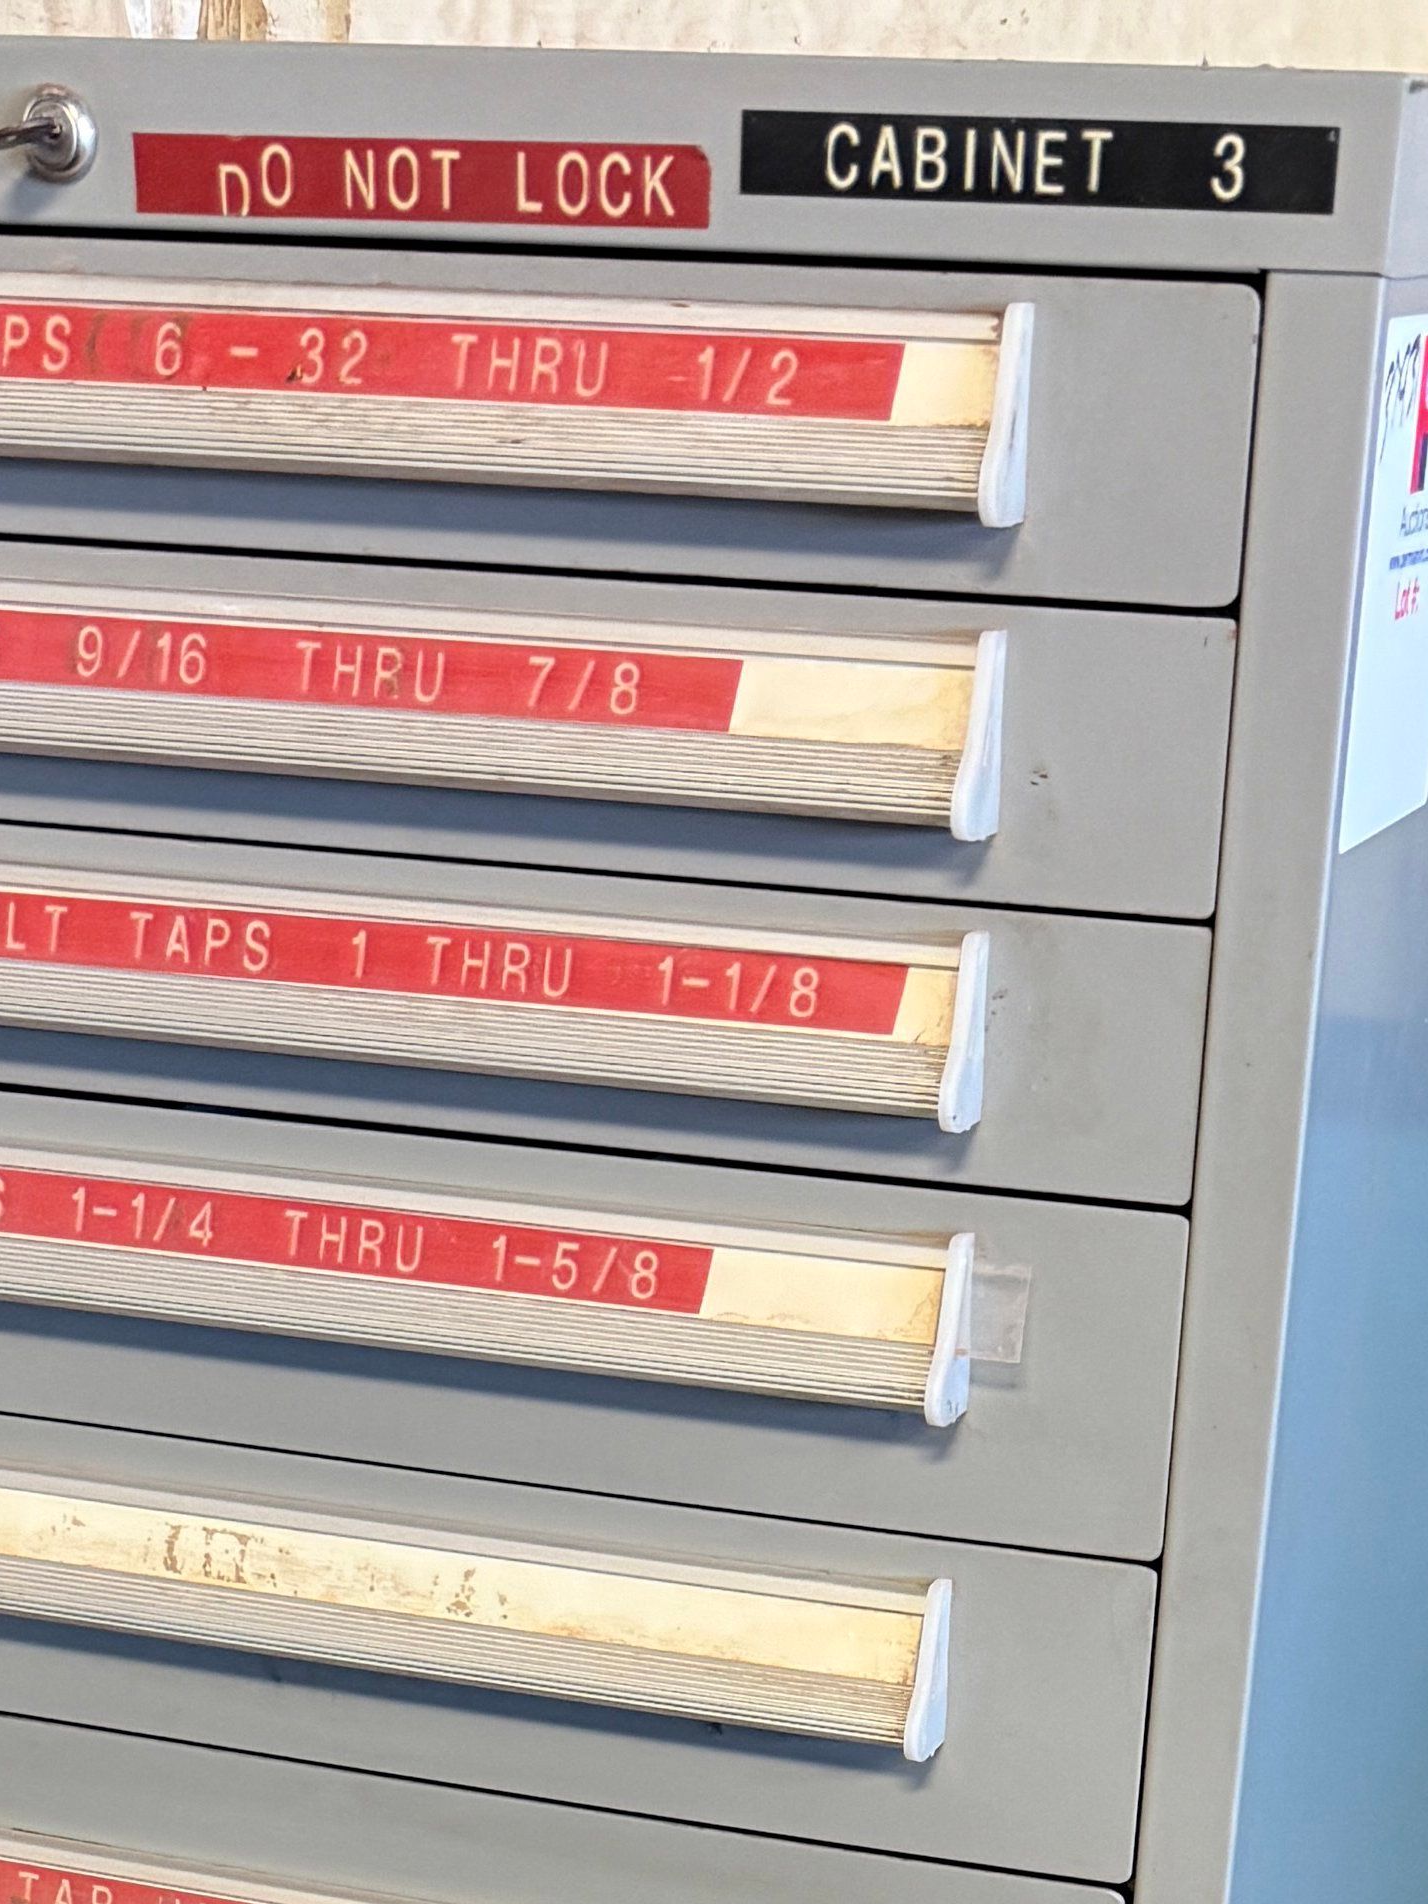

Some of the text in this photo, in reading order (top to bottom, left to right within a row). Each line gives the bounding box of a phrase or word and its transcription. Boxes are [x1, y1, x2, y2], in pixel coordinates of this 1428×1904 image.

[343, 150, 462, 213] NOT
[516, 152, 676, 220] LOCK
[825, 123, 1247, 200] CABINET 3
[153, 322, 182, 378] 6
[229, 344, 259, 358] -
[297, 327, 369, 385] 32
[451, 333, 608, 398] THRU
[697, 345, 800, 406] 1/2
[75, 625, 209, 686] 9/16
[295, 641, 446, 703] THRU
[527, 655, 641, 716] 7/8
[129, 911, 272, 974] TAPS
[351, 929, 369, 979] 1
[425, 935, 573, 999] THRU
[657, 955, 822, 1019] 1-1/8
[72, 1186, 215, 1248] 1-1/4
[284, 1208, 425, 1274] THRU
[492, 1235, 661, 1301] 1-5/8
